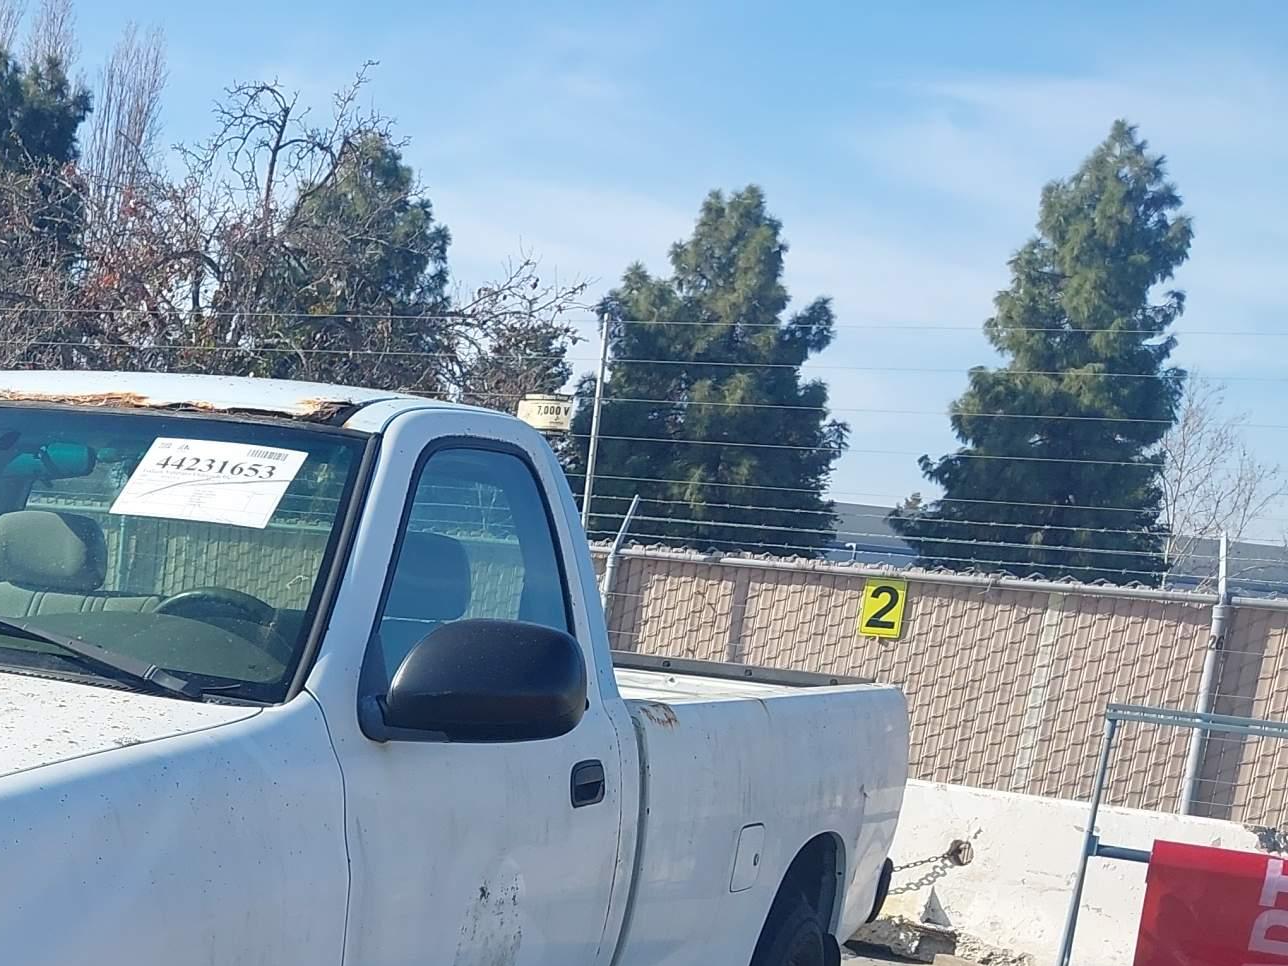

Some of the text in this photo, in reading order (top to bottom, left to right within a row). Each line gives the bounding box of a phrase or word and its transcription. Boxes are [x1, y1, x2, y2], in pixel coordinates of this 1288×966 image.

[537, 405, 571, 416] 7,000 V
[156, 455, 277, 480] 44231653
[865, 585, 899, 629] 2
[1208, 635, 1224, 650] 26
